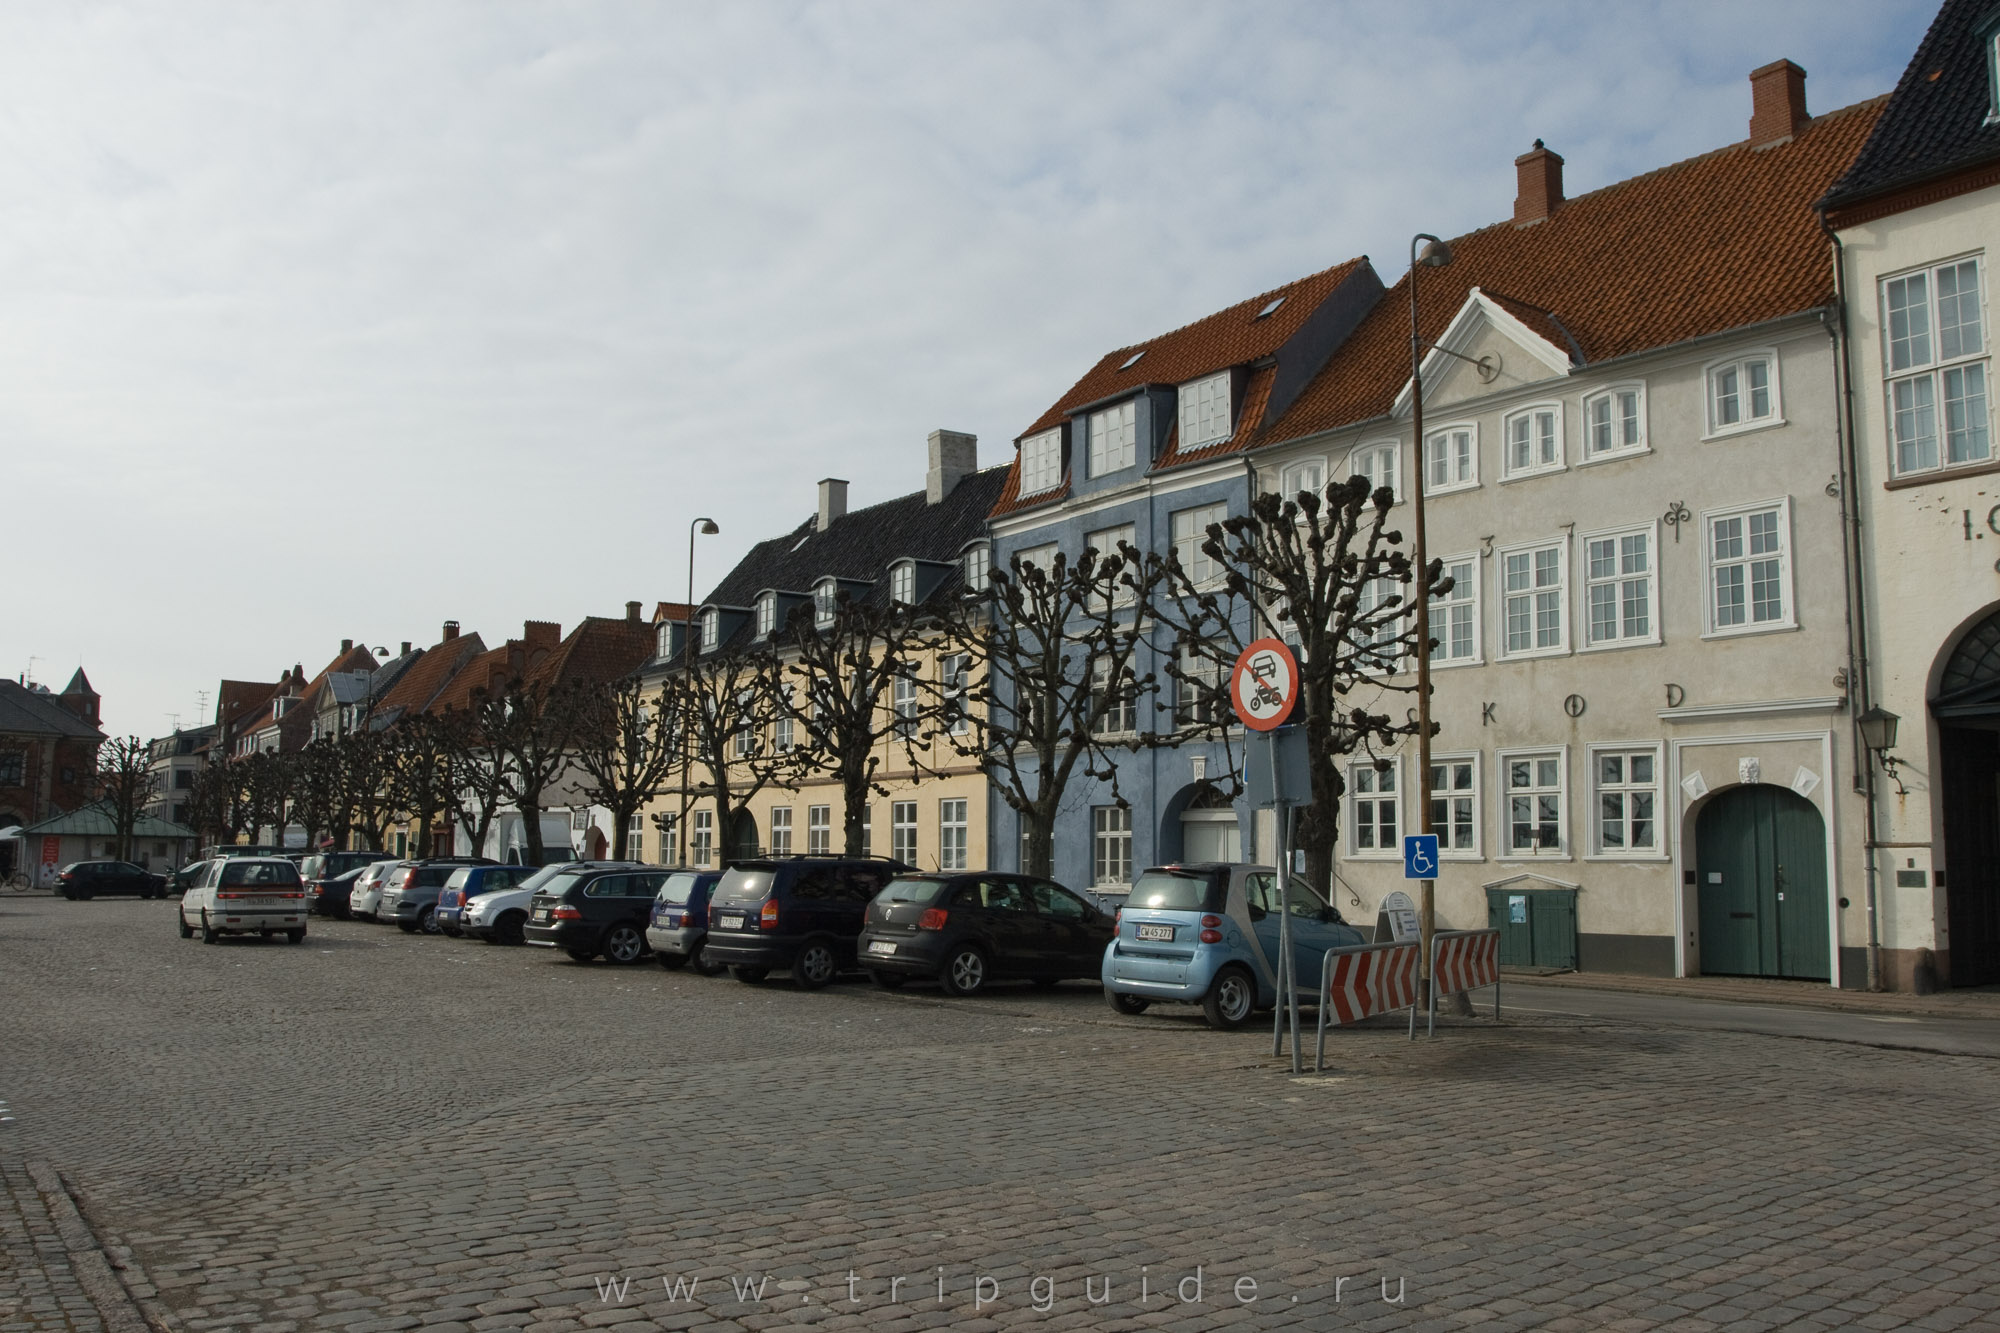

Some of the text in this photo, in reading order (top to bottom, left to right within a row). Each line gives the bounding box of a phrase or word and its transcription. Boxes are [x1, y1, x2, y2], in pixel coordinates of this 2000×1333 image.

[1141, 927, 1171, 938] CW 45 277
